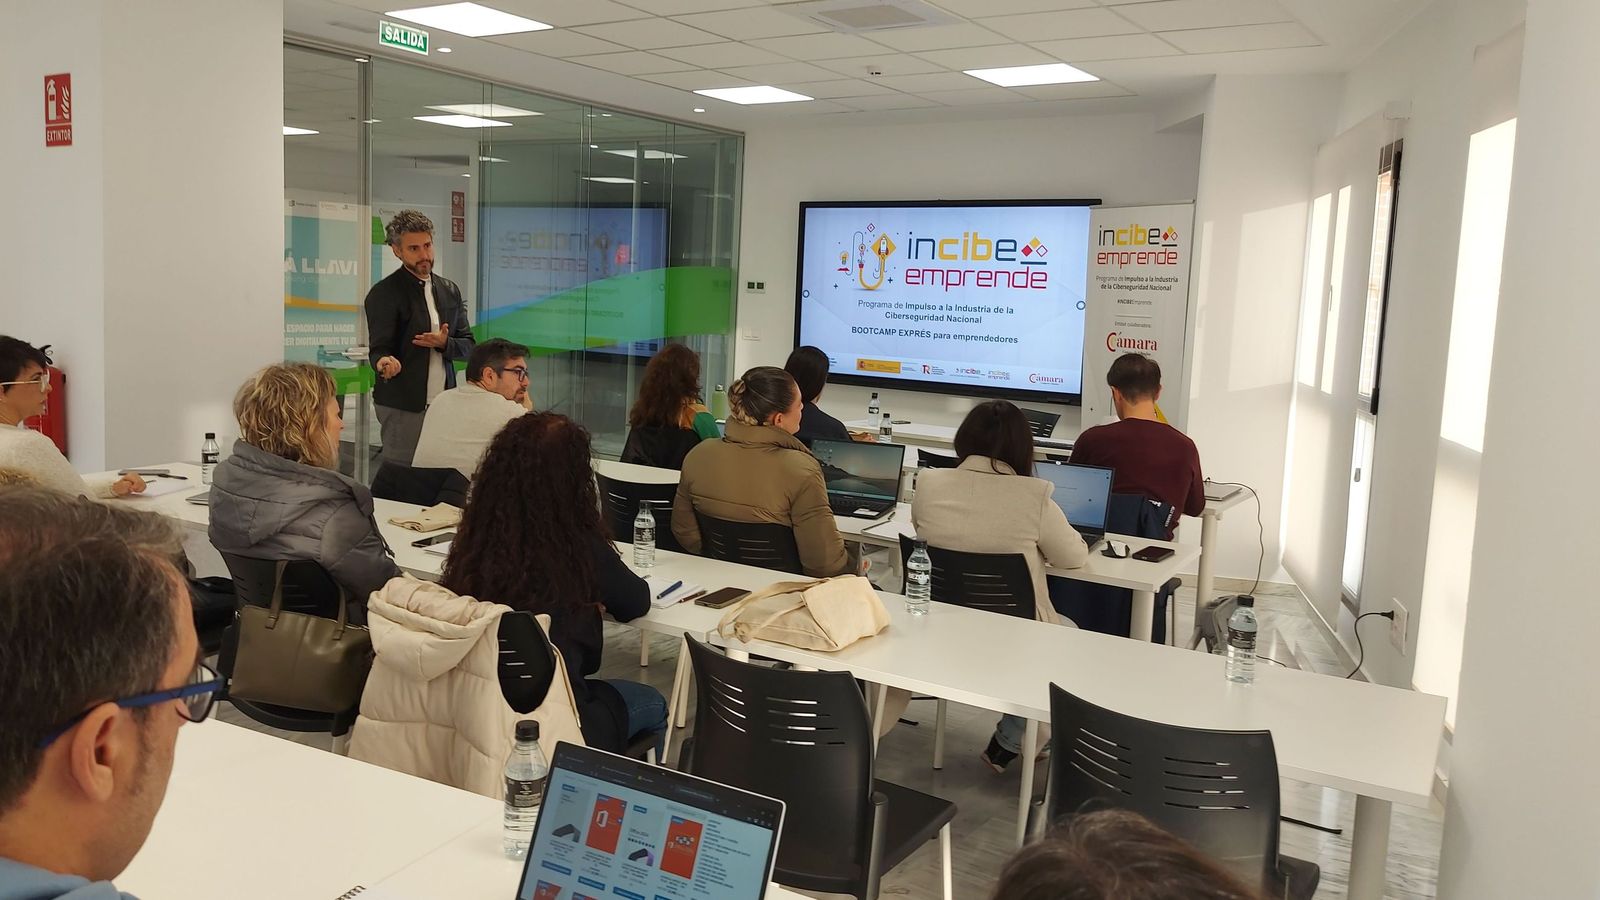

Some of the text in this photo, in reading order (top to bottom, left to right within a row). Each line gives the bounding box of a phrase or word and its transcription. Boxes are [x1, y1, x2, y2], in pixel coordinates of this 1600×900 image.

[385, 25, 425, 49] SALIDA
[47, 129, 71, 142] EXTINTOR
[1098, 224, 1160, 246] incibe
[908, 231, 1018, 262] incibe
[1097, 248, 1178, 269] emprende
[905, 266, 1048, 292] emprende
[858, 299, 893, 309] Programa
[894, 301, 904, 309] de
[905, 302, 937, 312] Impulso
[945, 303, 953, 311] la
[954, 303, 991, 313] Industria
[993, 305, 1004, 314] de
[1006, 306, 1014, 314] la
[885, 311, 982, 324] Ciberseguridad Nacional
[851, 326, 1019, 344] BOOTCAMP EXPRÉS para emprendedores
[1106, 331, 1158, 352] Cámara
[1029, 372, 1064, 384] Cámara
